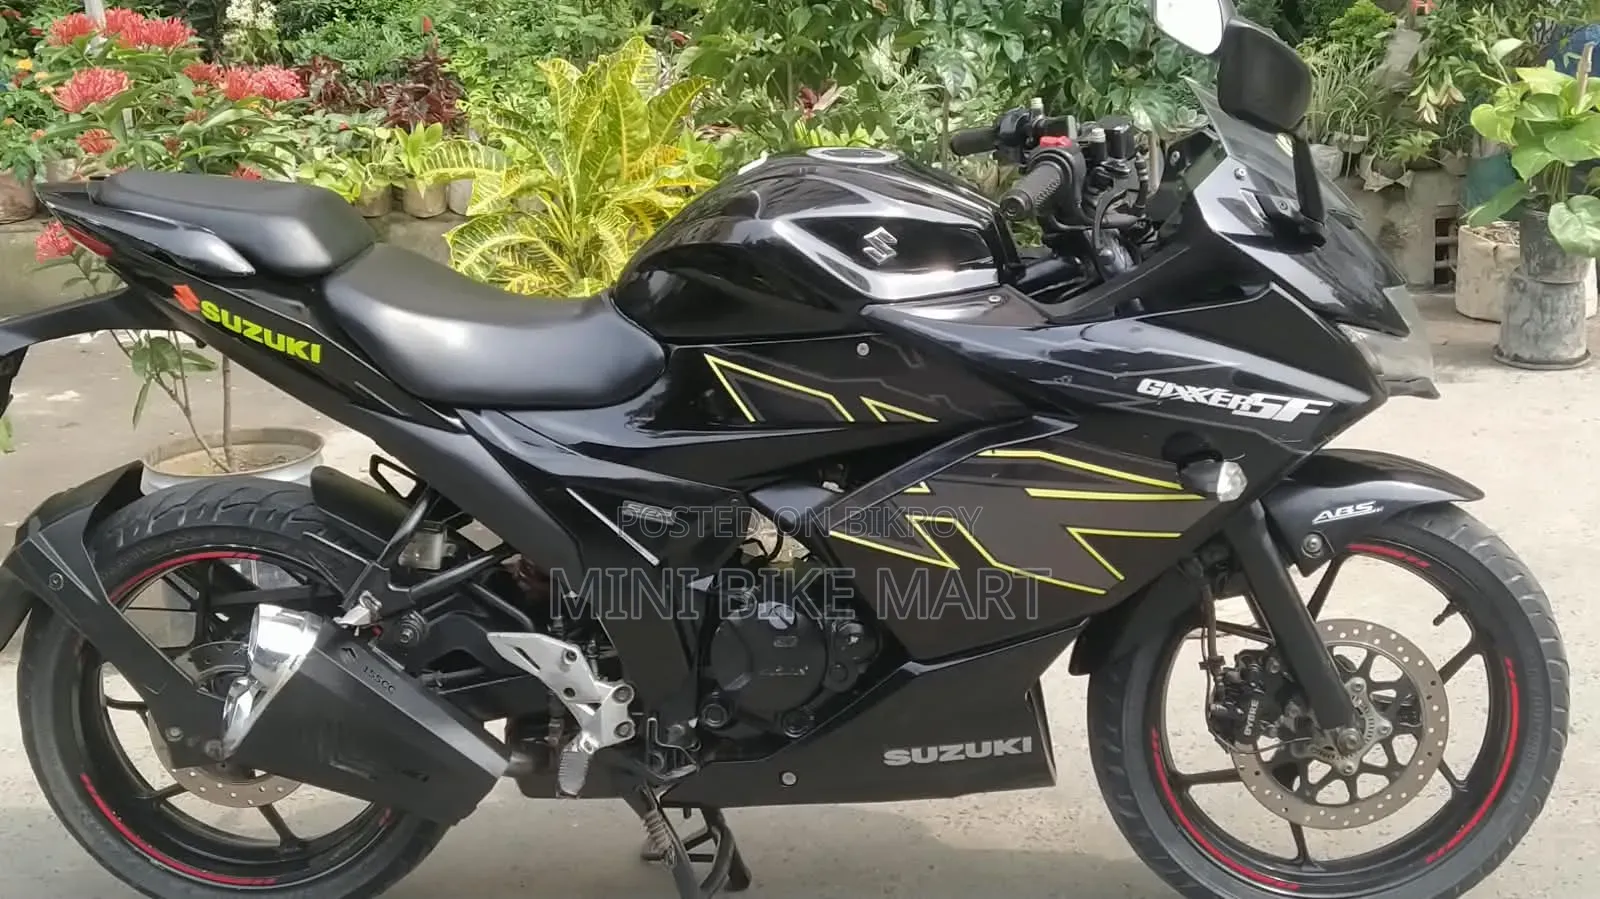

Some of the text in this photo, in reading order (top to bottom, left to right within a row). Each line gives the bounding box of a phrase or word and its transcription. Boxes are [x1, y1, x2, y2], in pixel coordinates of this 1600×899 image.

[201, 300, 321, 364] SUZUKI
[1312, 500, 1377, 525] ABS
[883, 736, 1032, 766] SUZUKI
